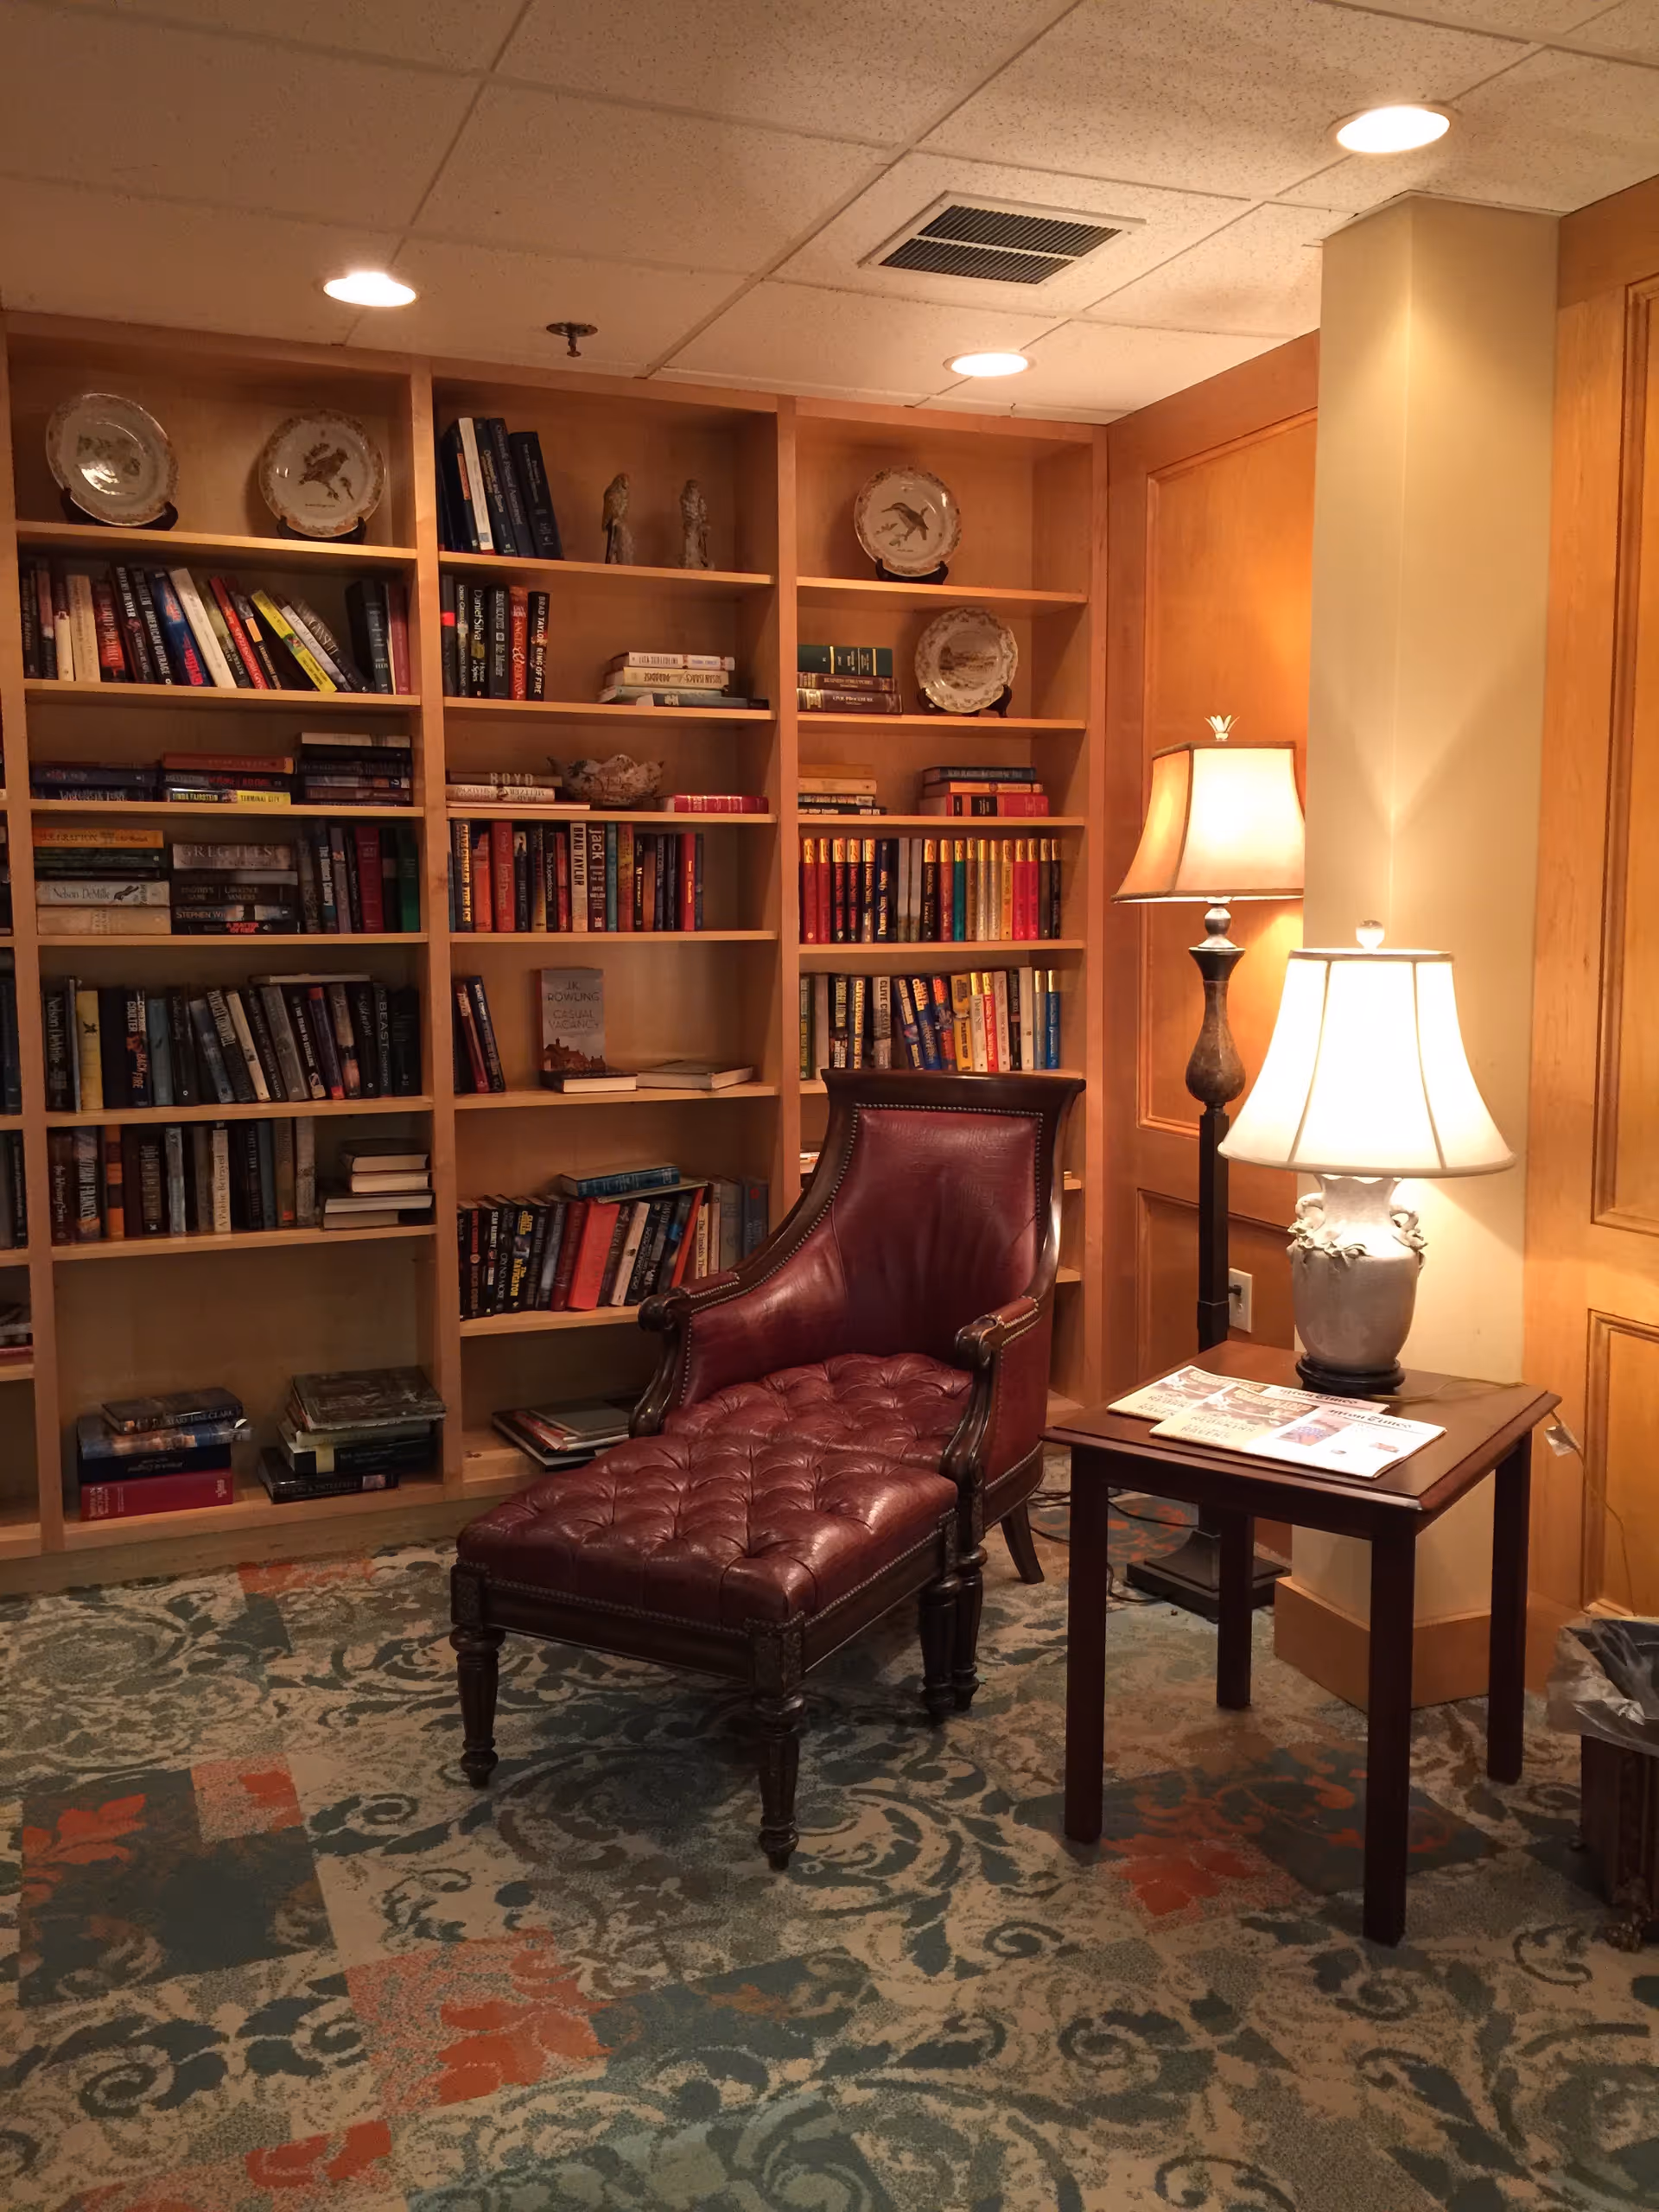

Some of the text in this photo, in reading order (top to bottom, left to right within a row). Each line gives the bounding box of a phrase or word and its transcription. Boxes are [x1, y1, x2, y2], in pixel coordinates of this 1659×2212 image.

[122, 593, 137, 618] DEAVER
[474, 589, 484, 640] Daniel Silva
[496, 607, 505, 629] KOONTZ
[537, 596, 546, 644] BRAD TAYLOR
[144, 611, 170, 675] AMERICAN OUTRAGE
[233, 626, 245, 647] CLARK
[513, 620, 523, 649] ANGELS
[513, 664, 523, 692] DEMONS
[535, 666, 543, 677] OF
[534, 677, 543, 694] FIRE
[490, 772, 534, 785] BOYD
[172, 792, 218, 802] LINDA FAIRSTEIN
[181, 846, 273, 858] GREG ILES
[319, 846, 329, 857] The
[573, 827, 584, 886] BRAD TAYLOR
[588, 830, 605, 859] jack
[461, 848, 470, 883] CUSSLER
[865, 864, 874, 885] DANIELLE
[54, 887, 111, 899] Nelson DeMille
[323, 882, 334, 906] Century
[462, 887, 471, 922] FIRE ICE
[176, 910, 213, 918] STEPHEN
[548, 991, 600, 1002] ROWLING
[880, 980, 888, 1002] CLIVE
[912, 978, 925, 1012] CUSSLER
[127, 1001, 138, 1033] COULTER
[295, 1007, 303, 1017] THE
[553, 1009, 595, 1019] CASUAL
[836, 982, 846, 1027] ROBERT LUDLUM
[855, 980, 864, 1034] CLIVE CUSSLER
[48, 996, 63, 1064] Nelson DeMille
[208, 990, 235, 1046] PATRICIA CORNWELL
[297, 1018, 307, 1033] TRAIN
[379, 1001, 390, 1049] BEAST
[132, 1053, 148, 1089] BACK FIRE
[216, 1154, 228, 1191] Betrayed
[79, 1185, 97, 1220] FRANZEN
[217, 1193, 226, 1218] Public
[519, 1211, 528, 1235] CUSSLER
[489, 1225, 498, 1249] HANNITY
[499, 1267, 507, 1278] NO
[510, 1258, 524, 1297] NAVIGATOR
[496, 1280, 505, 1300] MORE
